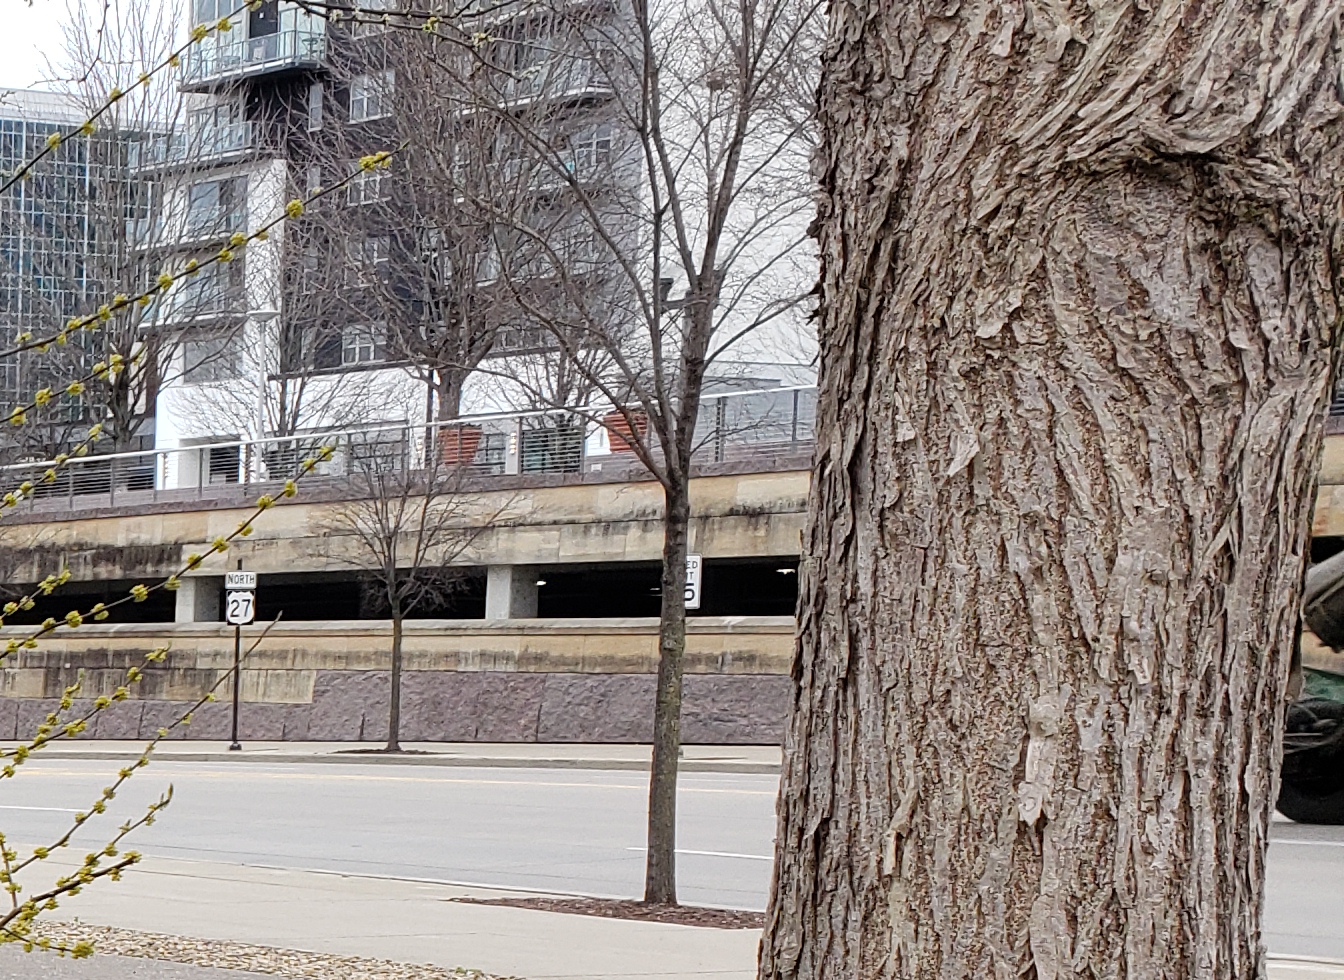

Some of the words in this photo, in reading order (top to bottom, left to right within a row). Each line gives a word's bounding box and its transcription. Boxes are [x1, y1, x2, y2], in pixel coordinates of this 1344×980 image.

[227, 574, 255, 585] NORTH
[684, 583, 695, 601] 5
[230, 599, 252, 618] 27
